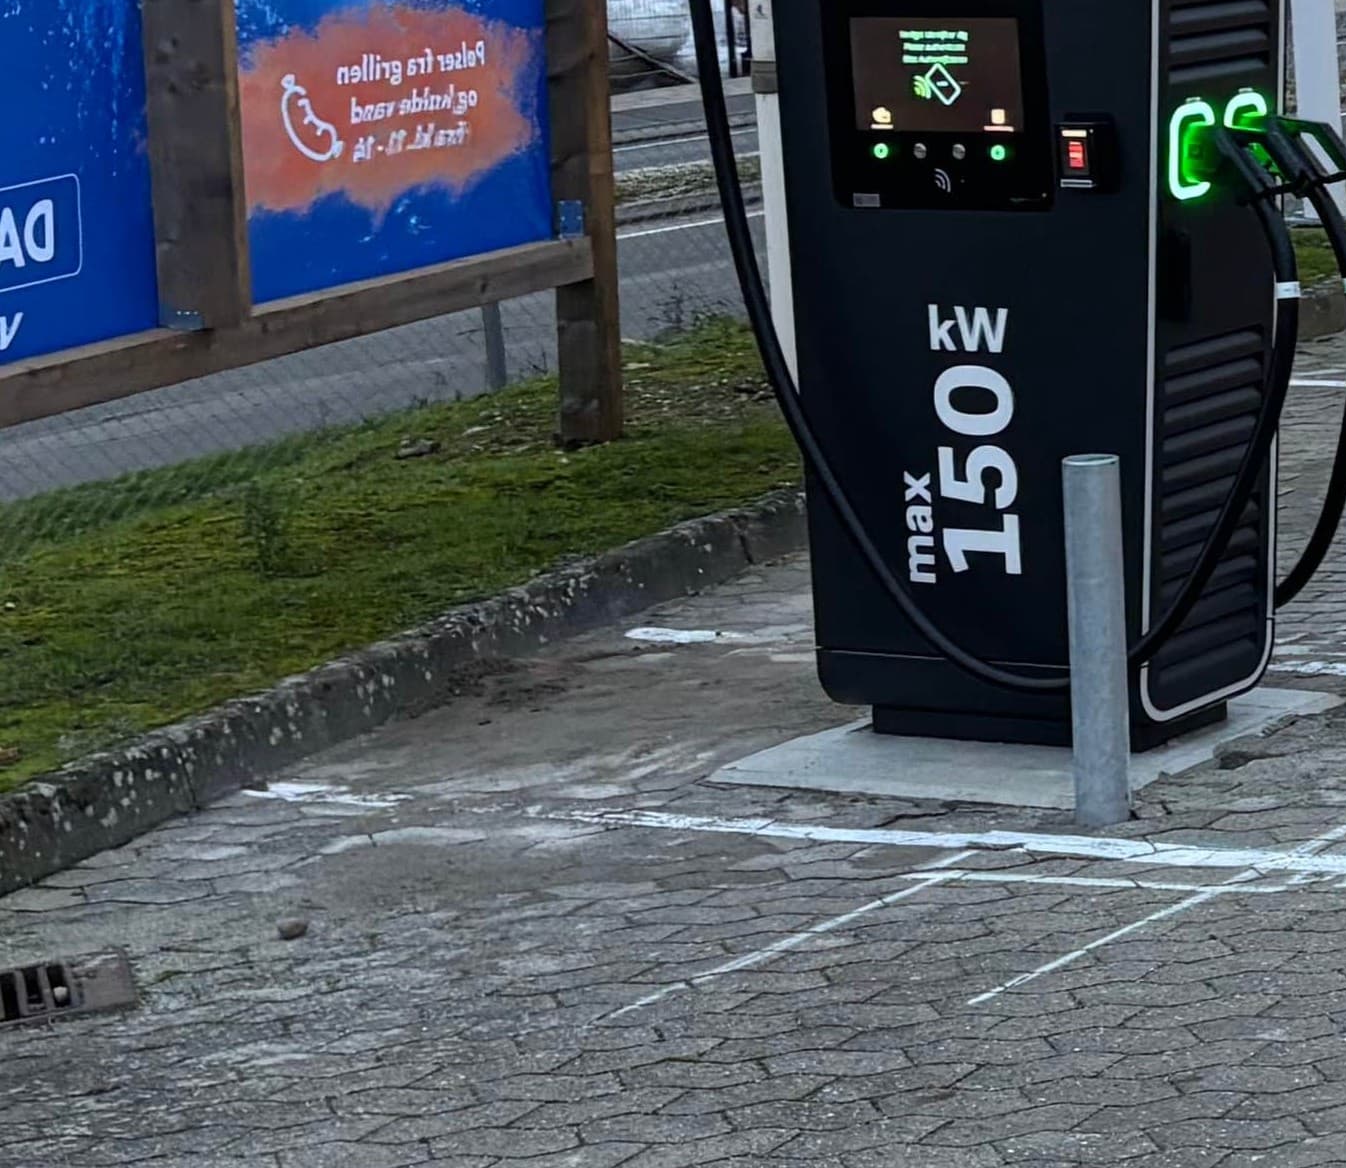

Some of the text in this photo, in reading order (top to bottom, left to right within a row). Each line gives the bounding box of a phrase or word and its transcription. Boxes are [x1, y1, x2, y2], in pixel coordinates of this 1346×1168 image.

[928, 304, 1008, 353] kW
[933, 365, 1022, 575] 150
[904, 471, 936, 584] max
